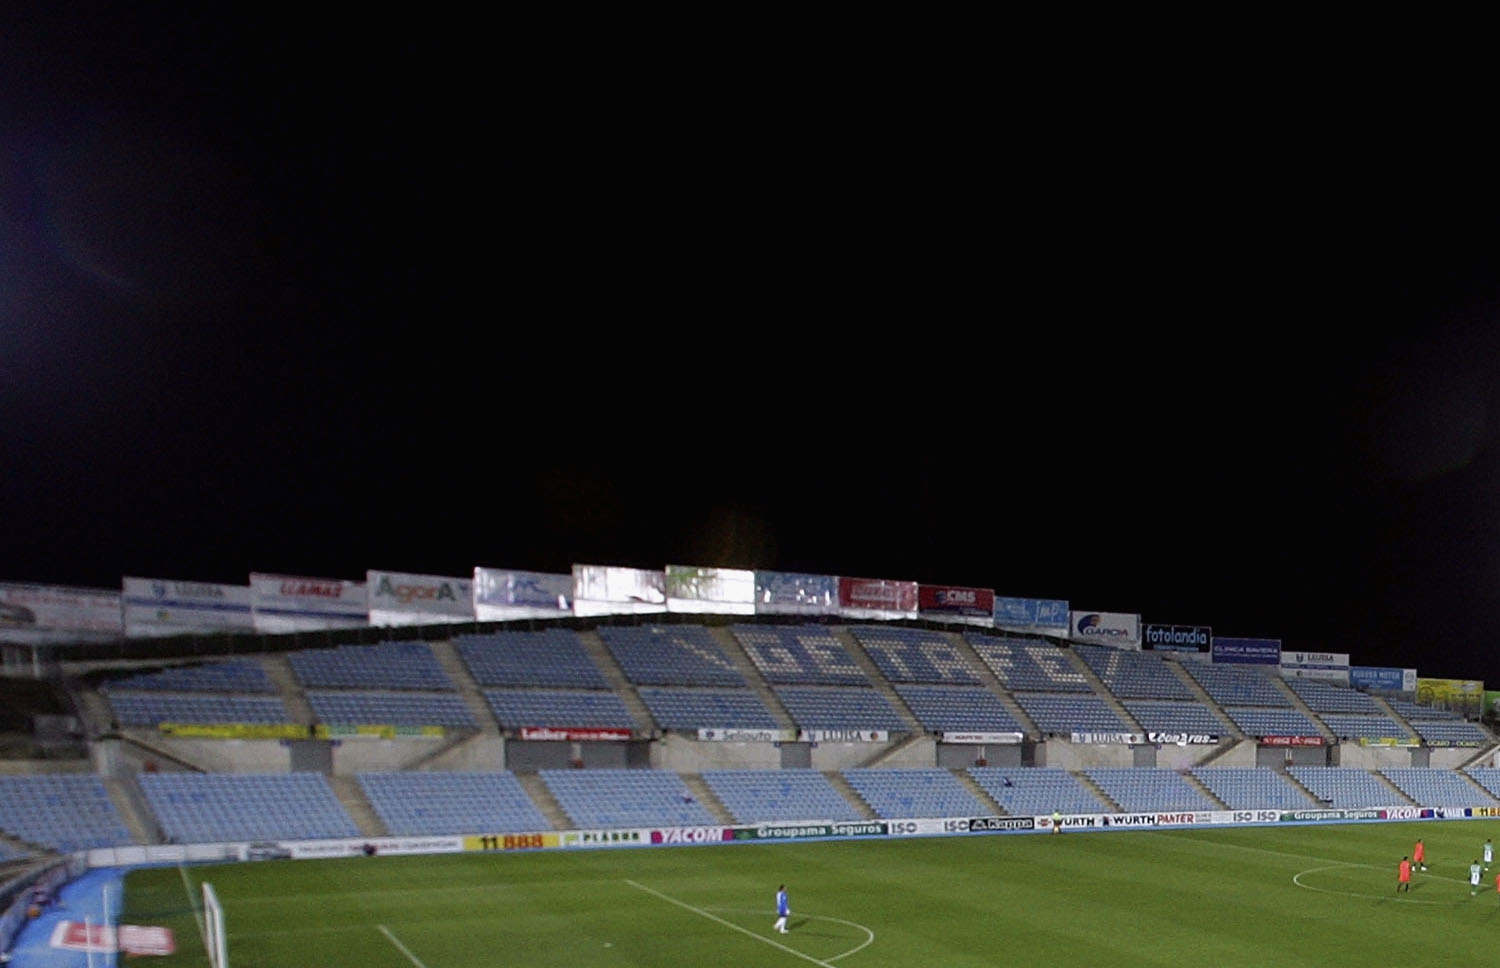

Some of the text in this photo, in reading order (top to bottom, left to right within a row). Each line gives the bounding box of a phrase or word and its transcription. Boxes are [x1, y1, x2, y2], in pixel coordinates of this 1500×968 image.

[1146, 625, 1207, 644] fotolandia
[1156, 812, 1195, 825] PANTER
[1233, 811, 1276, 822] ISO ISO
[1294, 810, 1378, 823] Groupama Seguros
[757, 822, 882, 840] Groupama Seguros
[891, 819, 969, 833] ISO ISO
[986, 818, 1034, 831] Kappa
